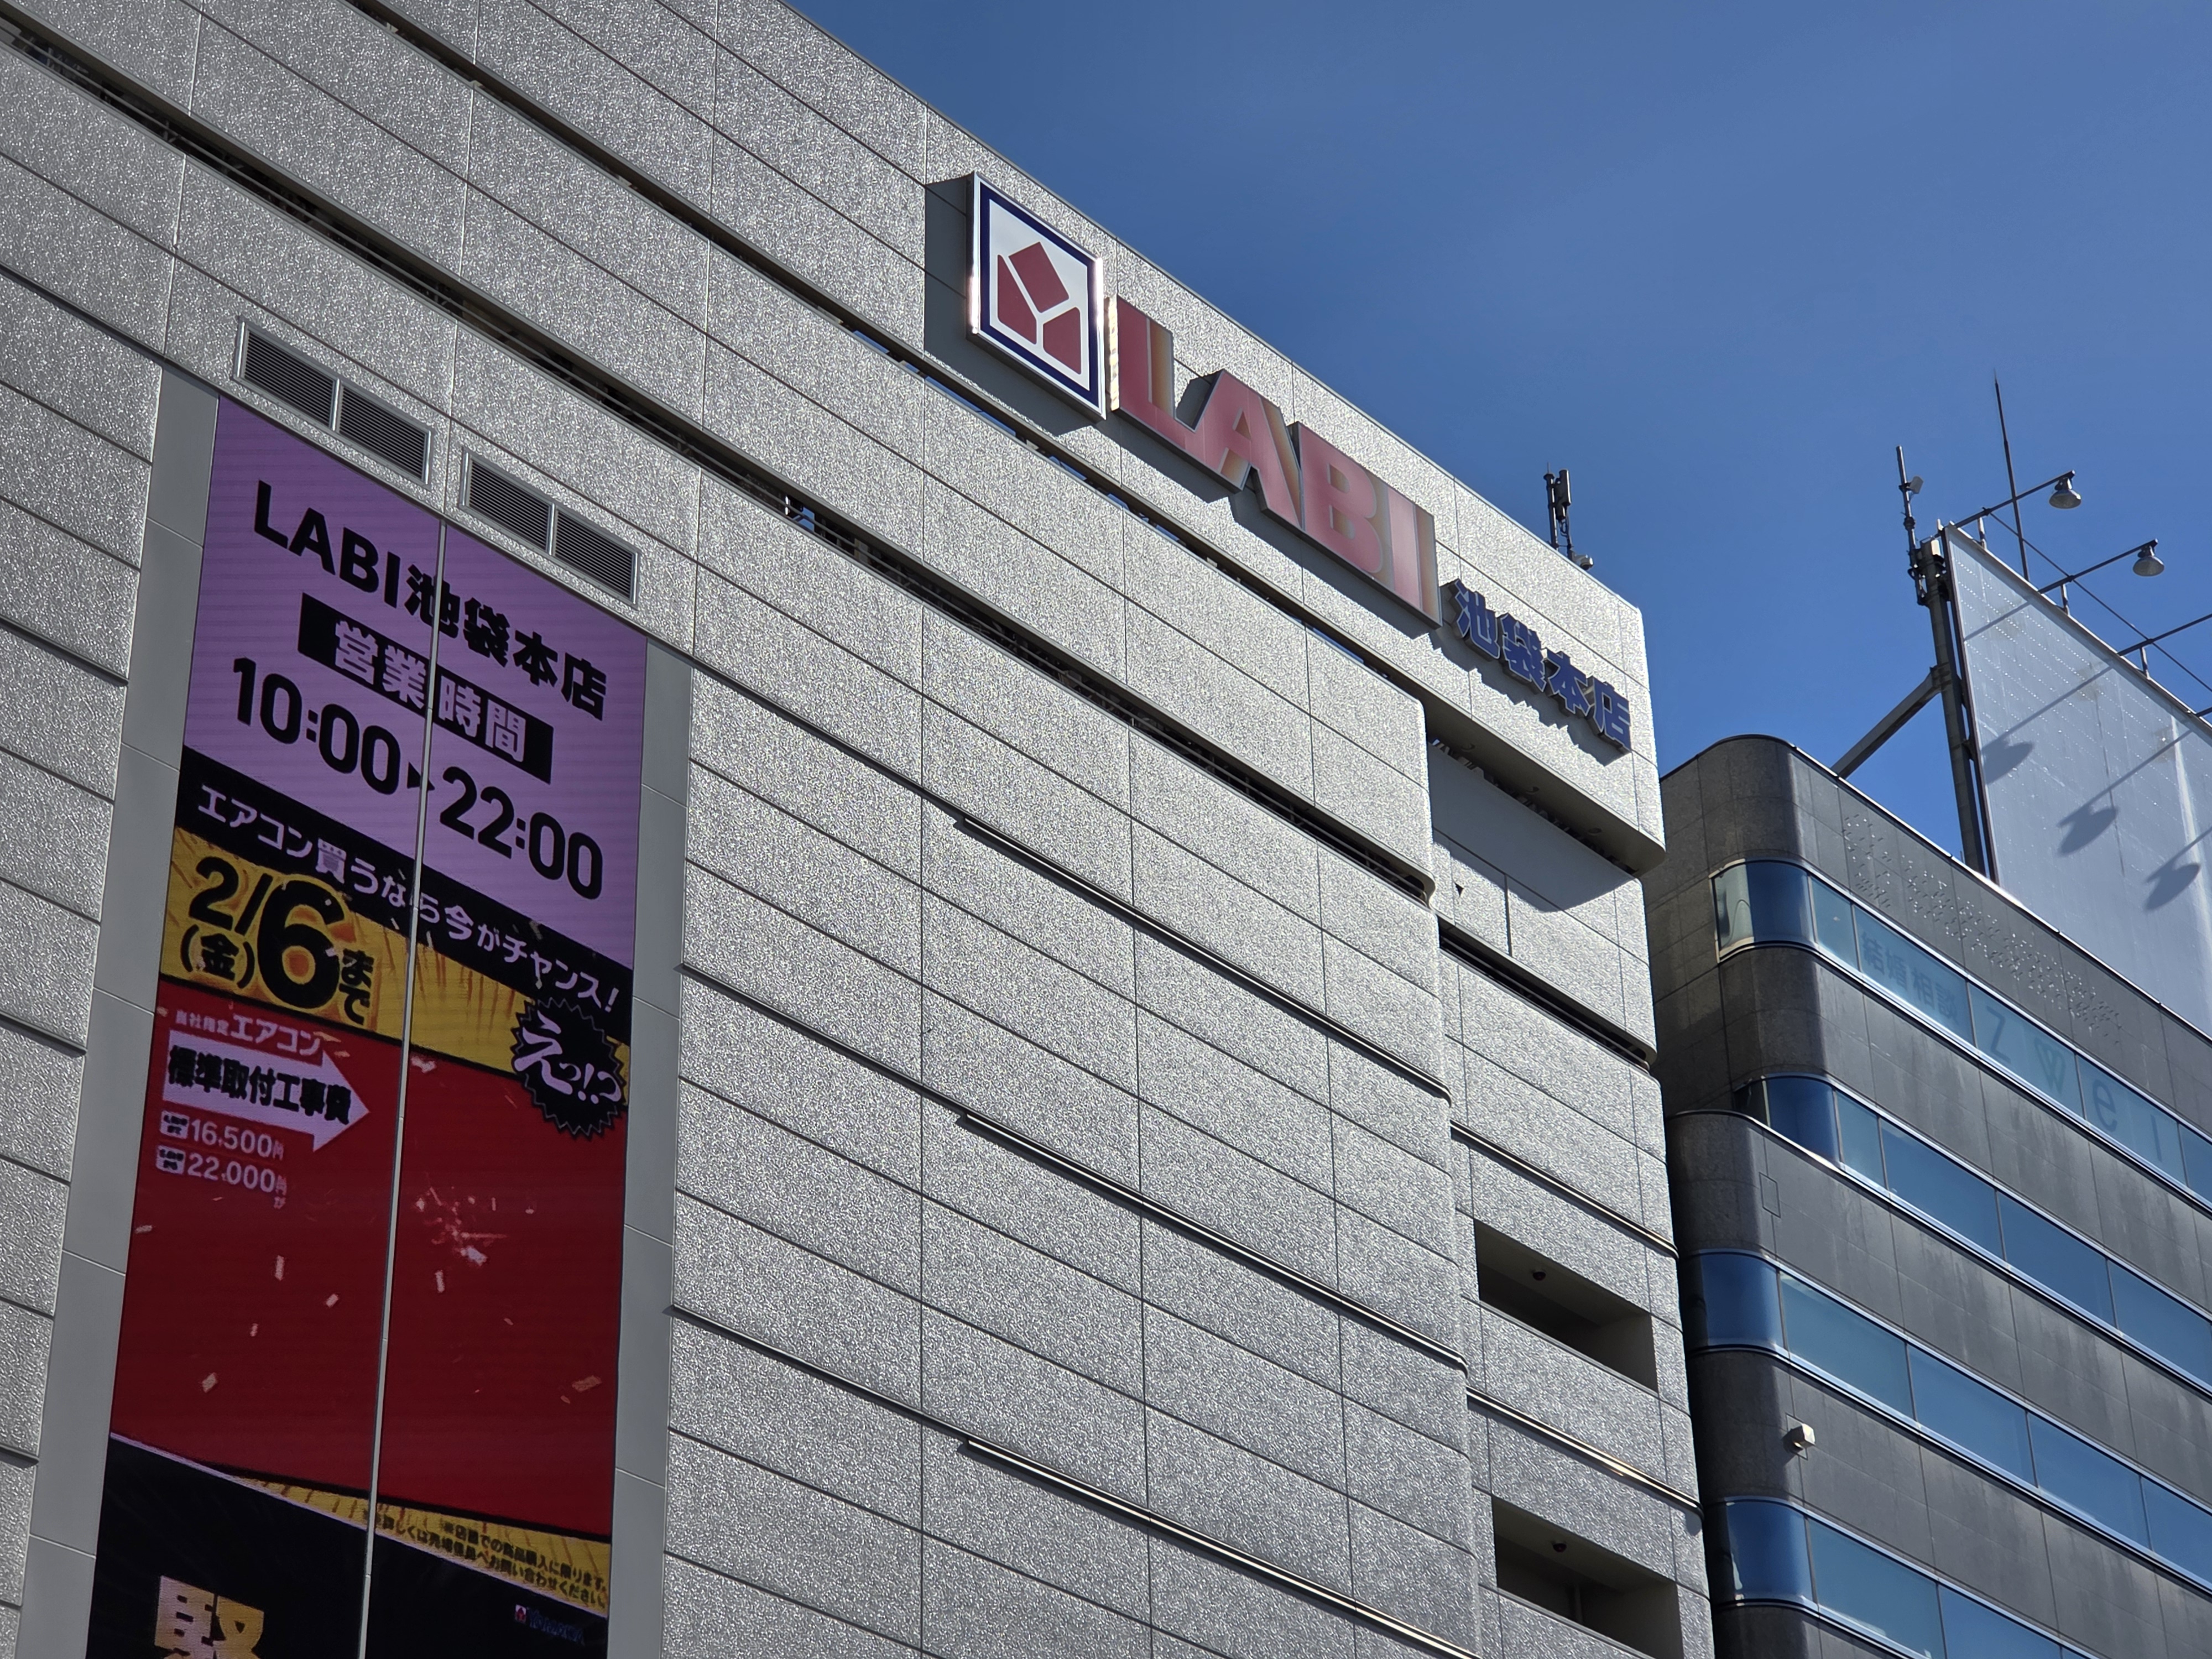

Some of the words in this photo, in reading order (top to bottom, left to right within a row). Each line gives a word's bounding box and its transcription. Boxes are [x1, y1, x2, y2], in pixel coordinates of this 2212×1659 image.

[253, 479, 607, 721] LABI池袋本店
[1113, 293, 1442, 627] LABI
[1452, 578, 1632, 753] 池袋本店
[232, 657, 401, 796] 10:00
[439, 765, 604, 901] 22:00
[334, 620, 527, 763] 営業時間
[188, 855, 347, 1009] 2/6
